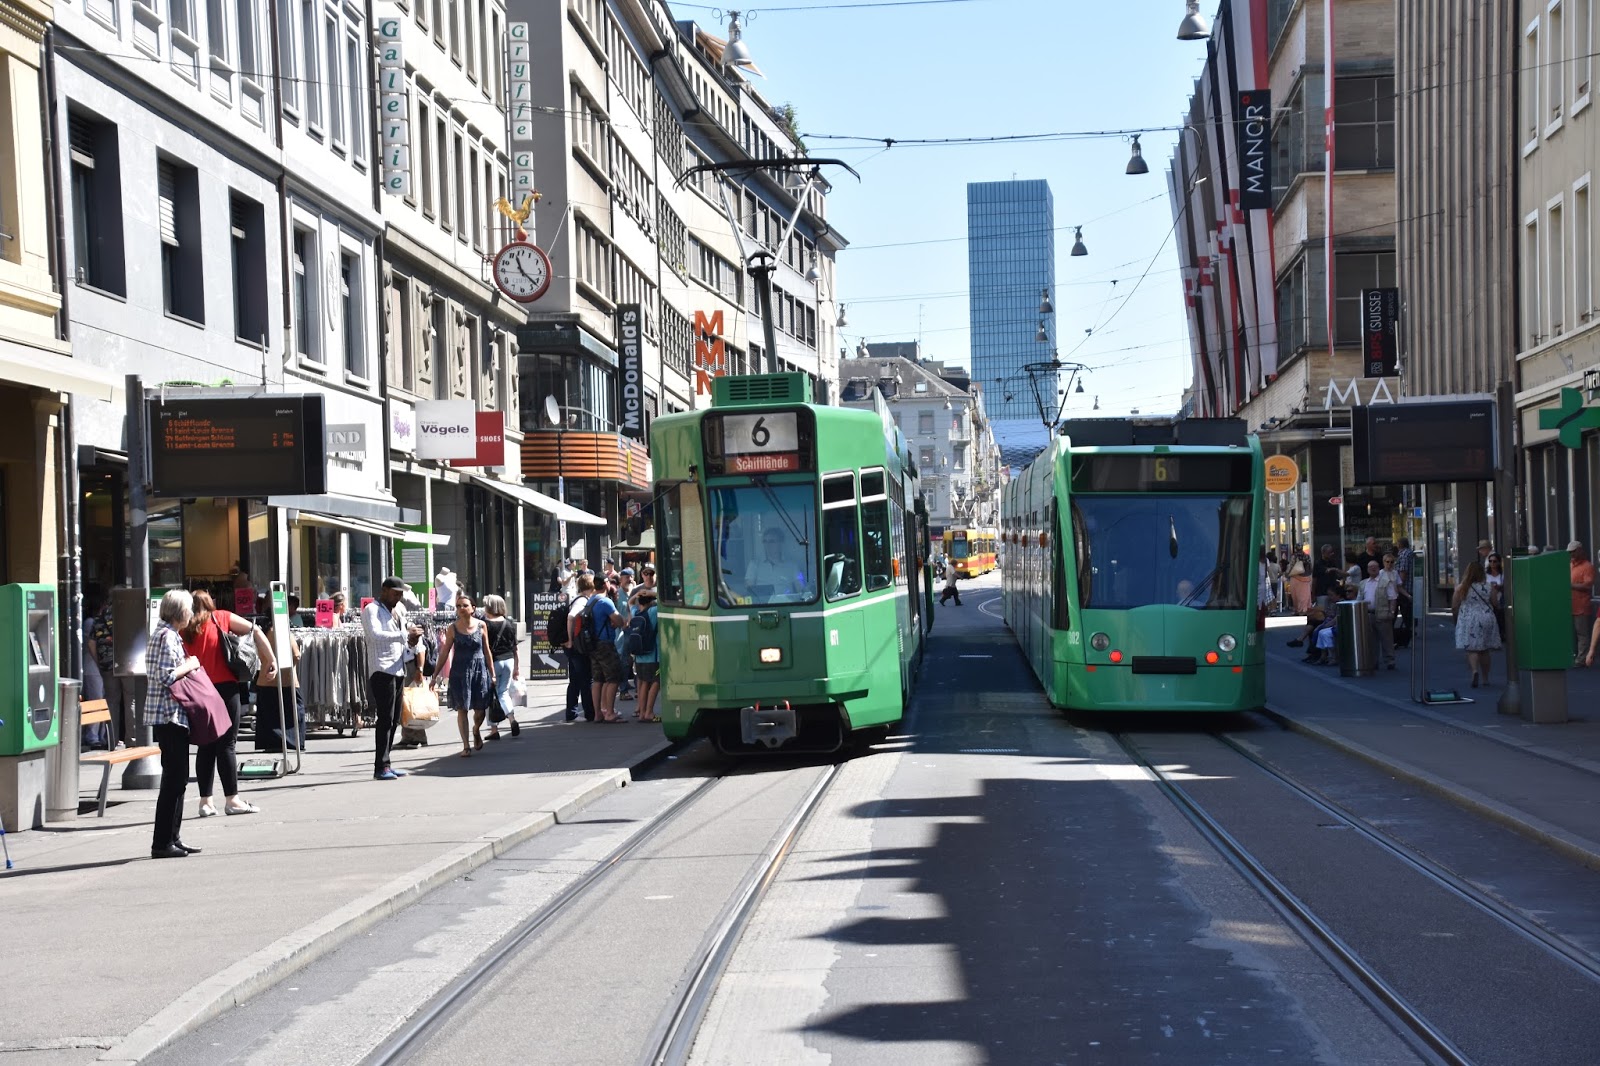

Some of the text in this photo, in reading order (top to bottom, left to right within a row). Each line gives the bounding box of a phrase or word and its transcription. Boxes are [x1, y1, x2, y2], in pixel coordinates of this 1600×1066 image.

[511, 24, 527, 135] Gryffe
[381, 20, 403, 189] Galerie
[1246, 104, 1264, 193] MANOR
[1369, 290, 1382, 332] (SUISSE)
[622, 311, 639, 429] McDonald's
[420, 424, 470, 436] Vögele
[752, 416, 770, 447] 6
[736, 456, 788, 471] Schifflände
[1156, 458, 1167, 482] 6
[317, 602, 332, 612] 15.-
[534, 593, 556, 602] Natel
[698, 634, 710, 650] 671
